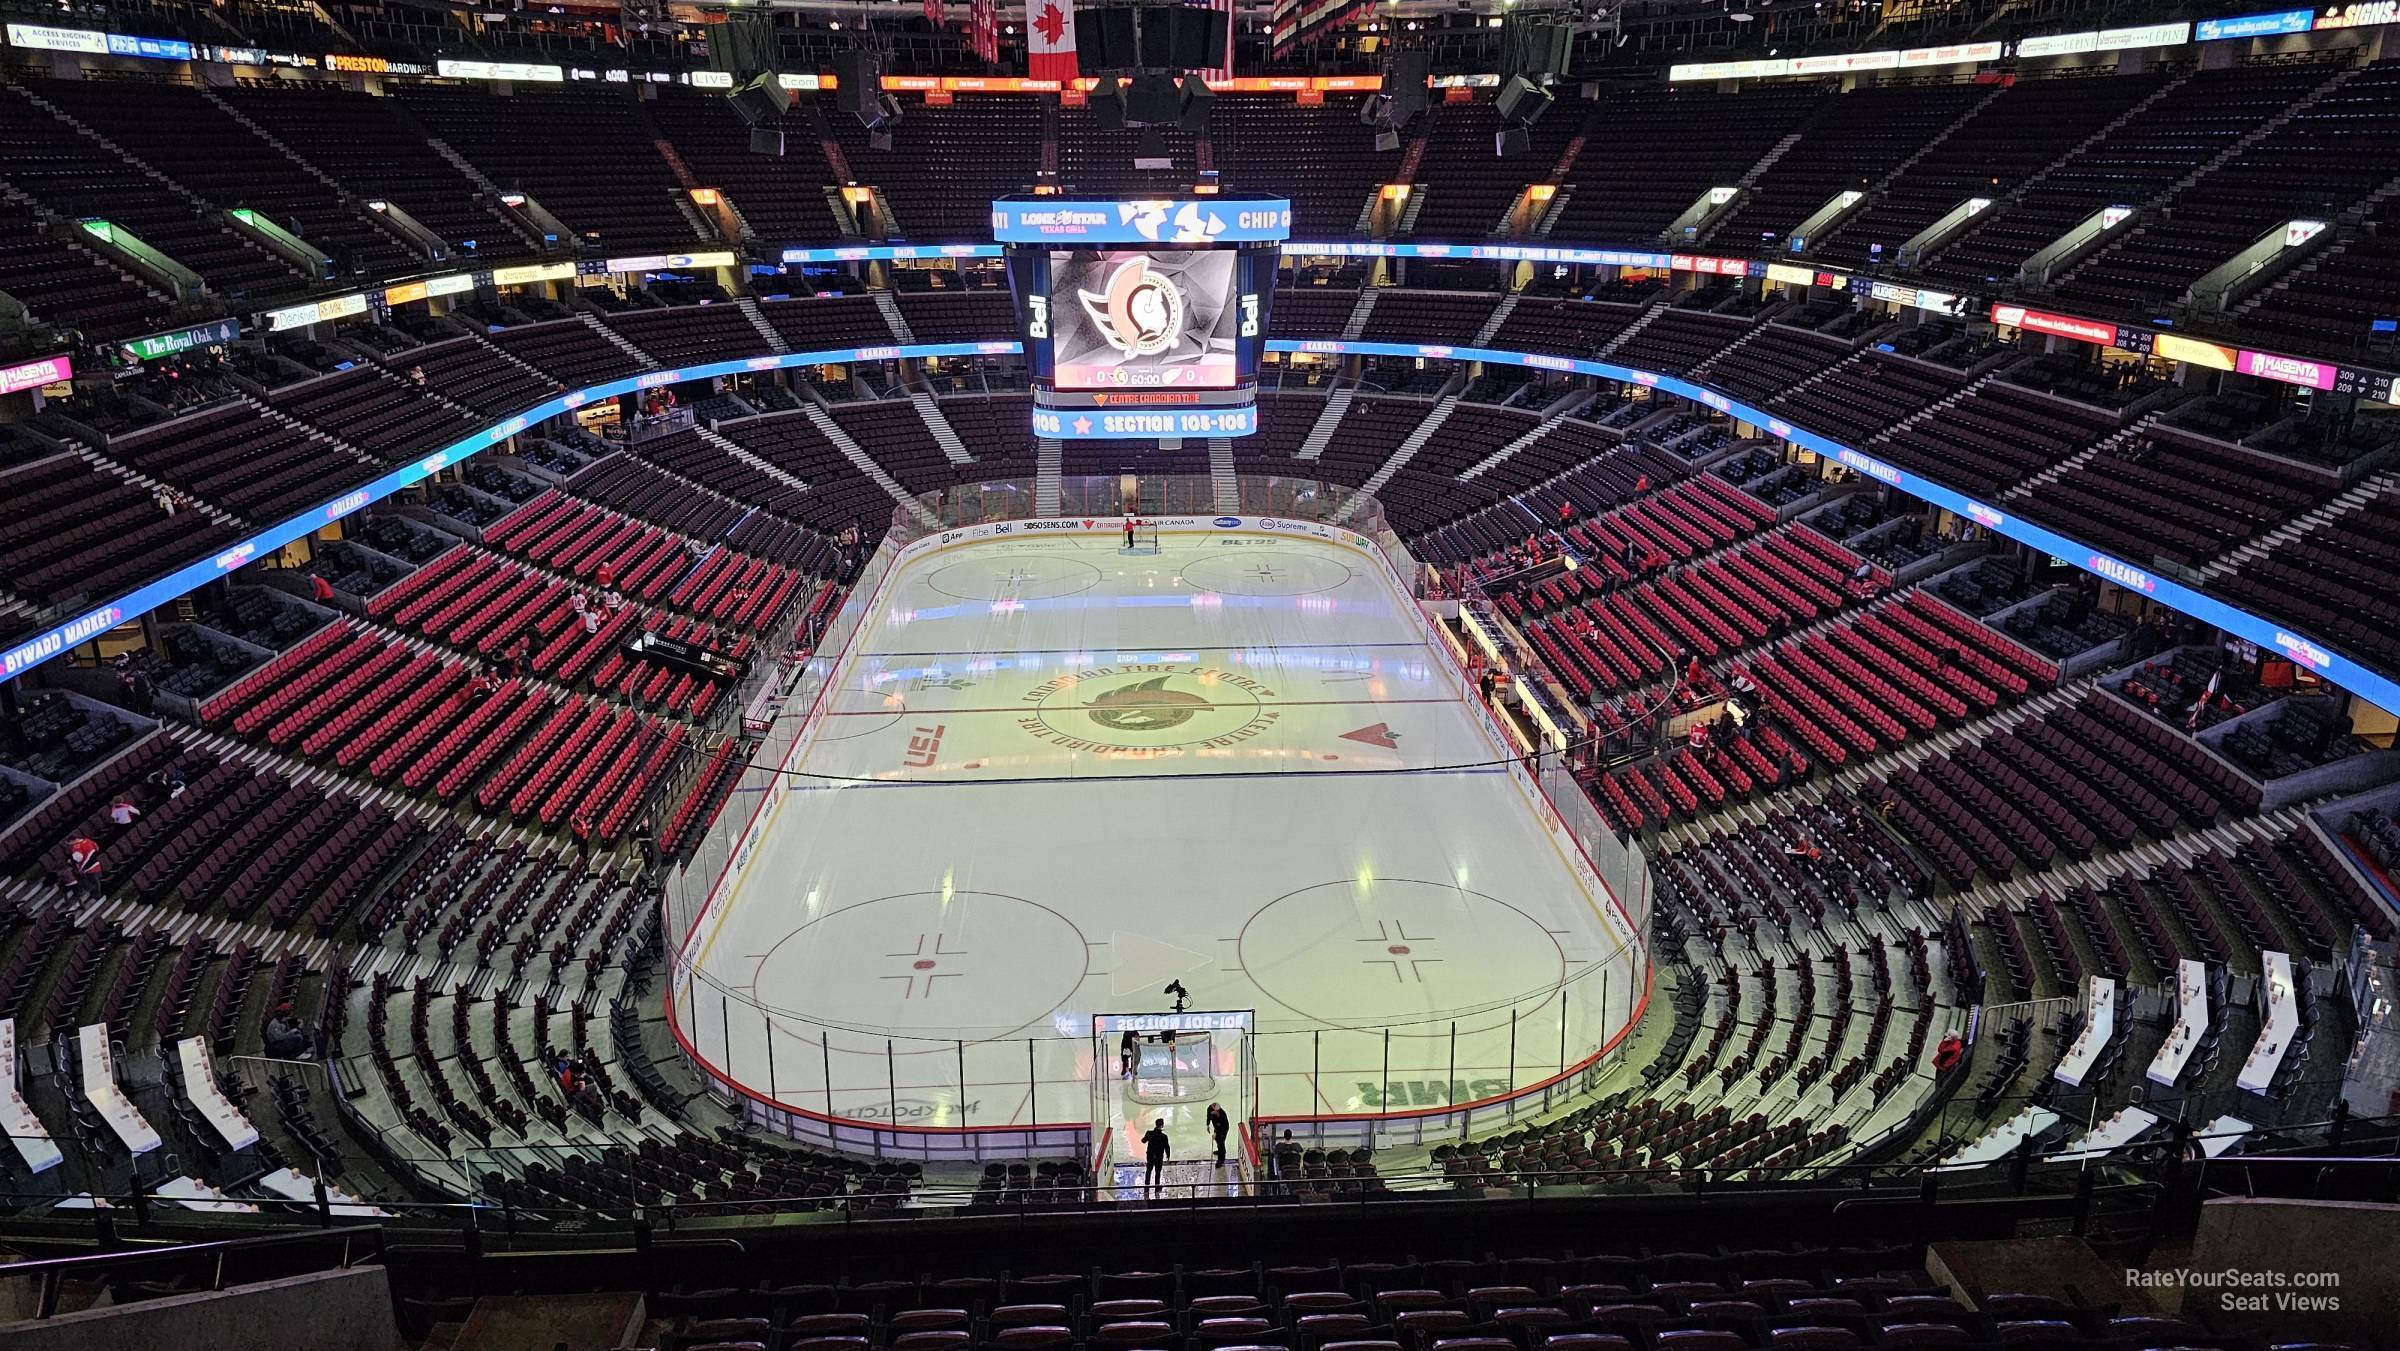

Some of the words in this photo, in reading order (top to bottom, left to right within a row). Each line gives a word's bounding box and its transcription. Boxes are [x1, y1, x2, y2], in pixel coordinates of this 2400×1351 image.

[336, 55, 387, 73] PRESTON
[387, 61, 433, 75] HARDWARE
[695, 74, 729, 84] LIVE
[1239, 212, 1275, 229] CHIP
[1030, 295, 1047, 338] Bell
[1241, 294, 1258, 337] Bell
[143, 337, 165, 355] The
[165, 331, 193, 353] Royal
[193, 328, 213, 344] Oak
[8, 363, 57, 383] MAGENTA
[2265, 357, 2319, 378] MAGENTA
[1097, 371, 1105, 382] 0
[1131, 374, 1160, 385] 60:00
[1187, 370, 1194, 382] 0
[2339, 370, 2355, 381] 309
[2374, 376, 2389, 388] 310
[1110, 394, 1139, 404] CENTRE
[1140, 394, 1182, 404] CANADIAN
[1183, 394, 1200, 403] TIRE
[2336, 382, 2352, 393] 209
[2371, 389, 2387, 401] 210
[1104, 415, 1174, 433] SECTION
[972, 527, 988, 537] Fibe
[995, 523, 1012, 535] Bell
[1277, 520, 1308, 532] Supreme
[1342, 531, 1370, 550] SUBWAY
[2097, 557, 2145, 590] ORLEANS
[5, 633, 61, 673] BYWARD
[64, 608, 113, 644] MARKET
[1022, 667, 1114, 702] CANADIAN
[1121, 664, 1176, 673] TIRE
[1356, 1078, 1511, 1107] BMR
